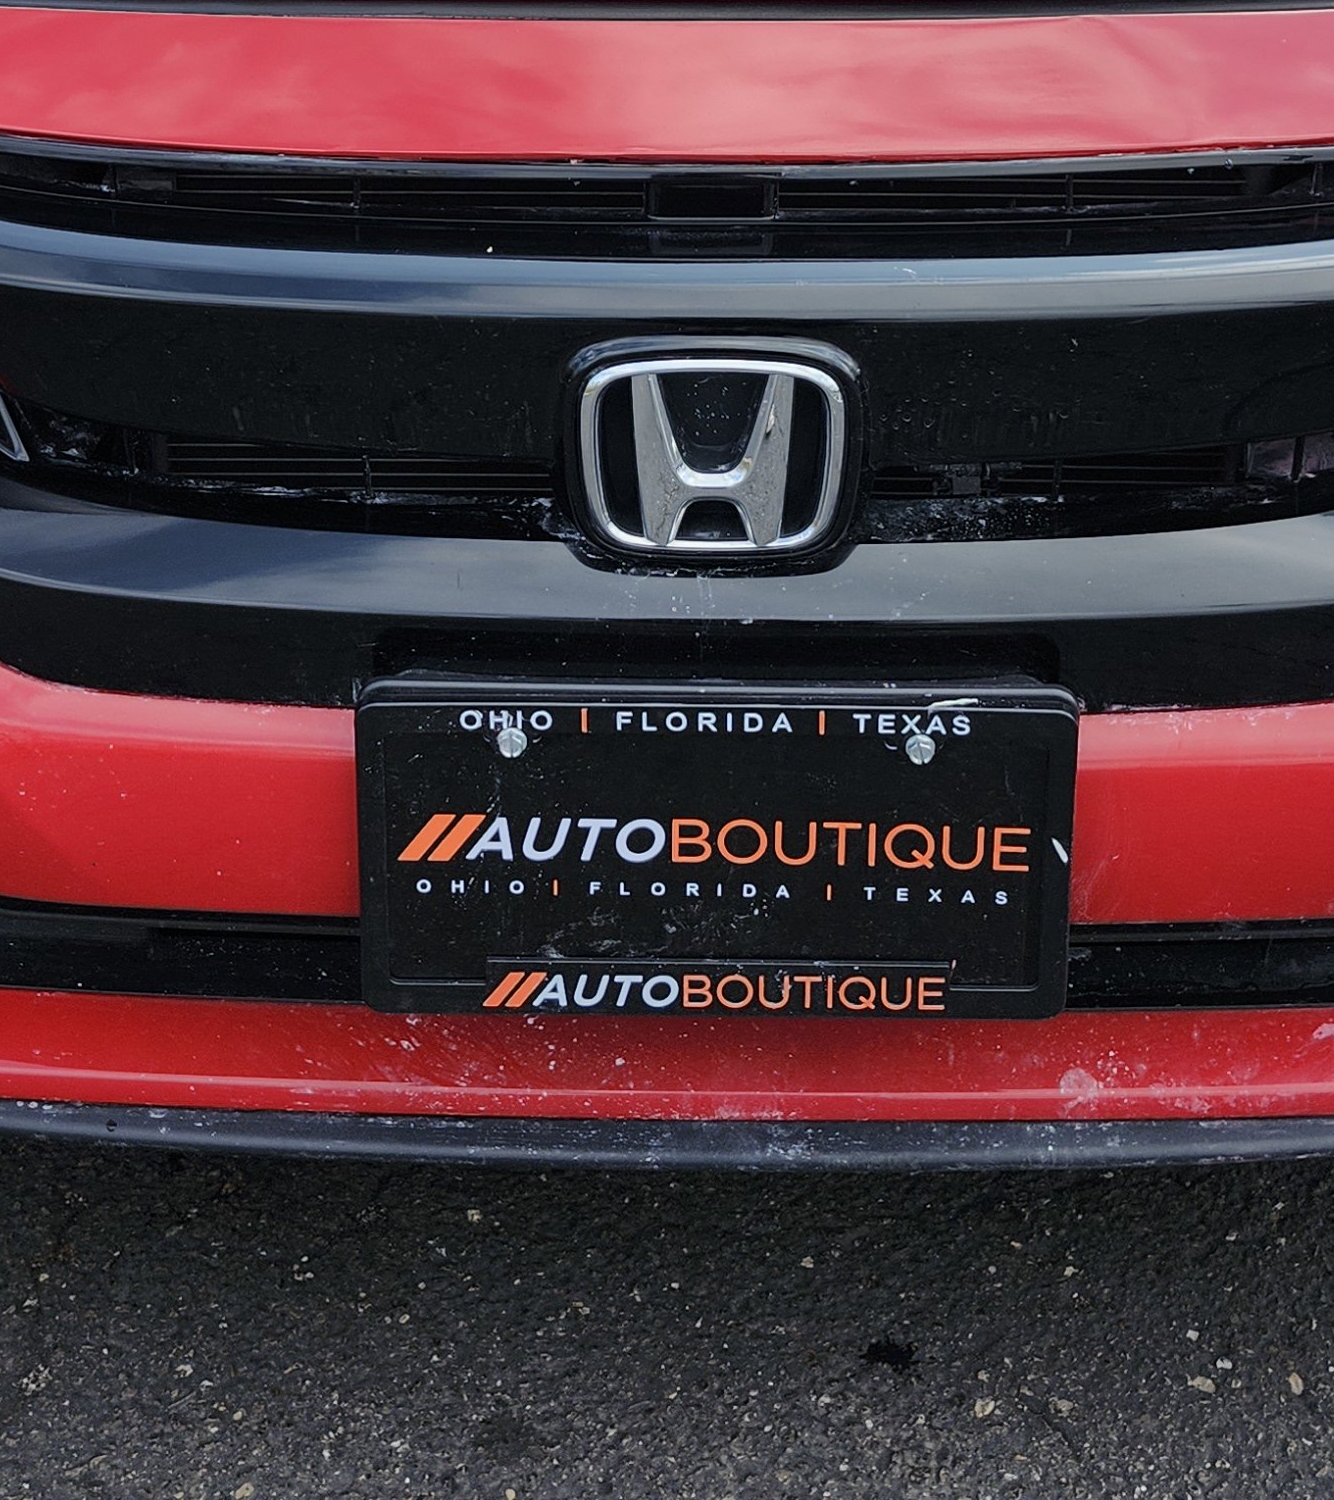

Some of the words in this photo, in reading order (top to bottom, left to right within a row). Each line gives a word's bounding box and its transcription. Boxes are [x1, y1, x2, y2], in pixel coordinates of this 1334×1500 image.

[459, 710, 553, 731] OHIO
[616, 710, 793, 733] FLORIDA
[852, 713, 972, 736] TEXAS
[464, 816, 1031, 872] AUTOBOUTIQUE
[416, 878, 525, 895] OHIO
[589, 881, 791, 899] FLORIDA
[863, 886, 1009, 906] TEXAS
[531, 973, 946, 1011] AUTOBOUTIQUE
